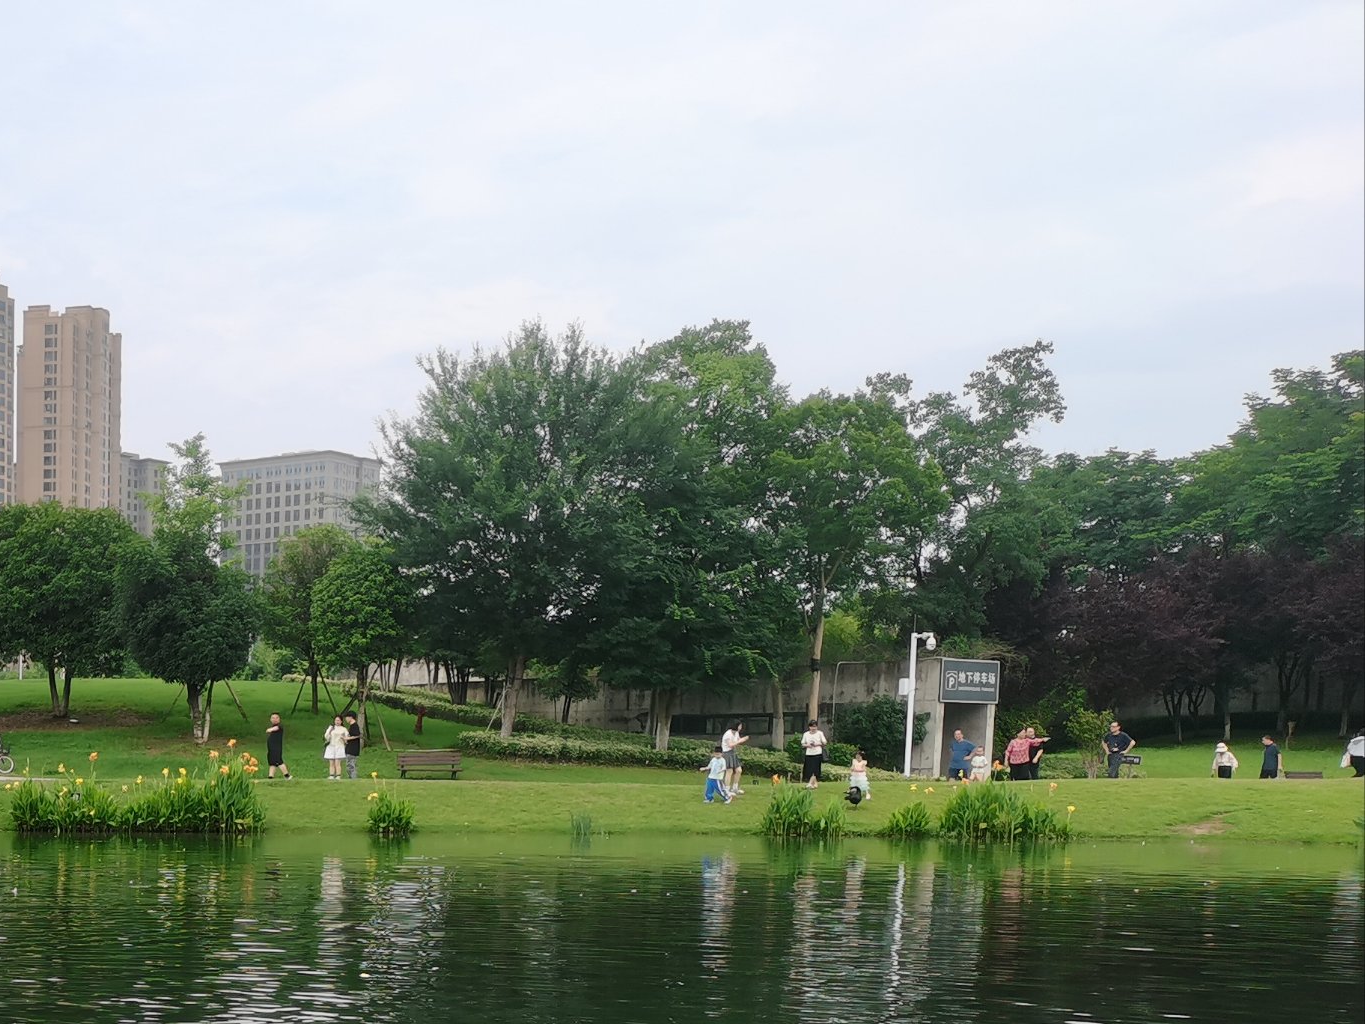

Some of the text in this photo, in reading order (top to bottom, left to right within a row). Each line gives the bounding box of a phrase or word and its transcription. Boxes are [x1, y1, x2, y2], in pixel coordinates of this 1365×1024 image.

[958, 670, 996, 685] 地下停车场
